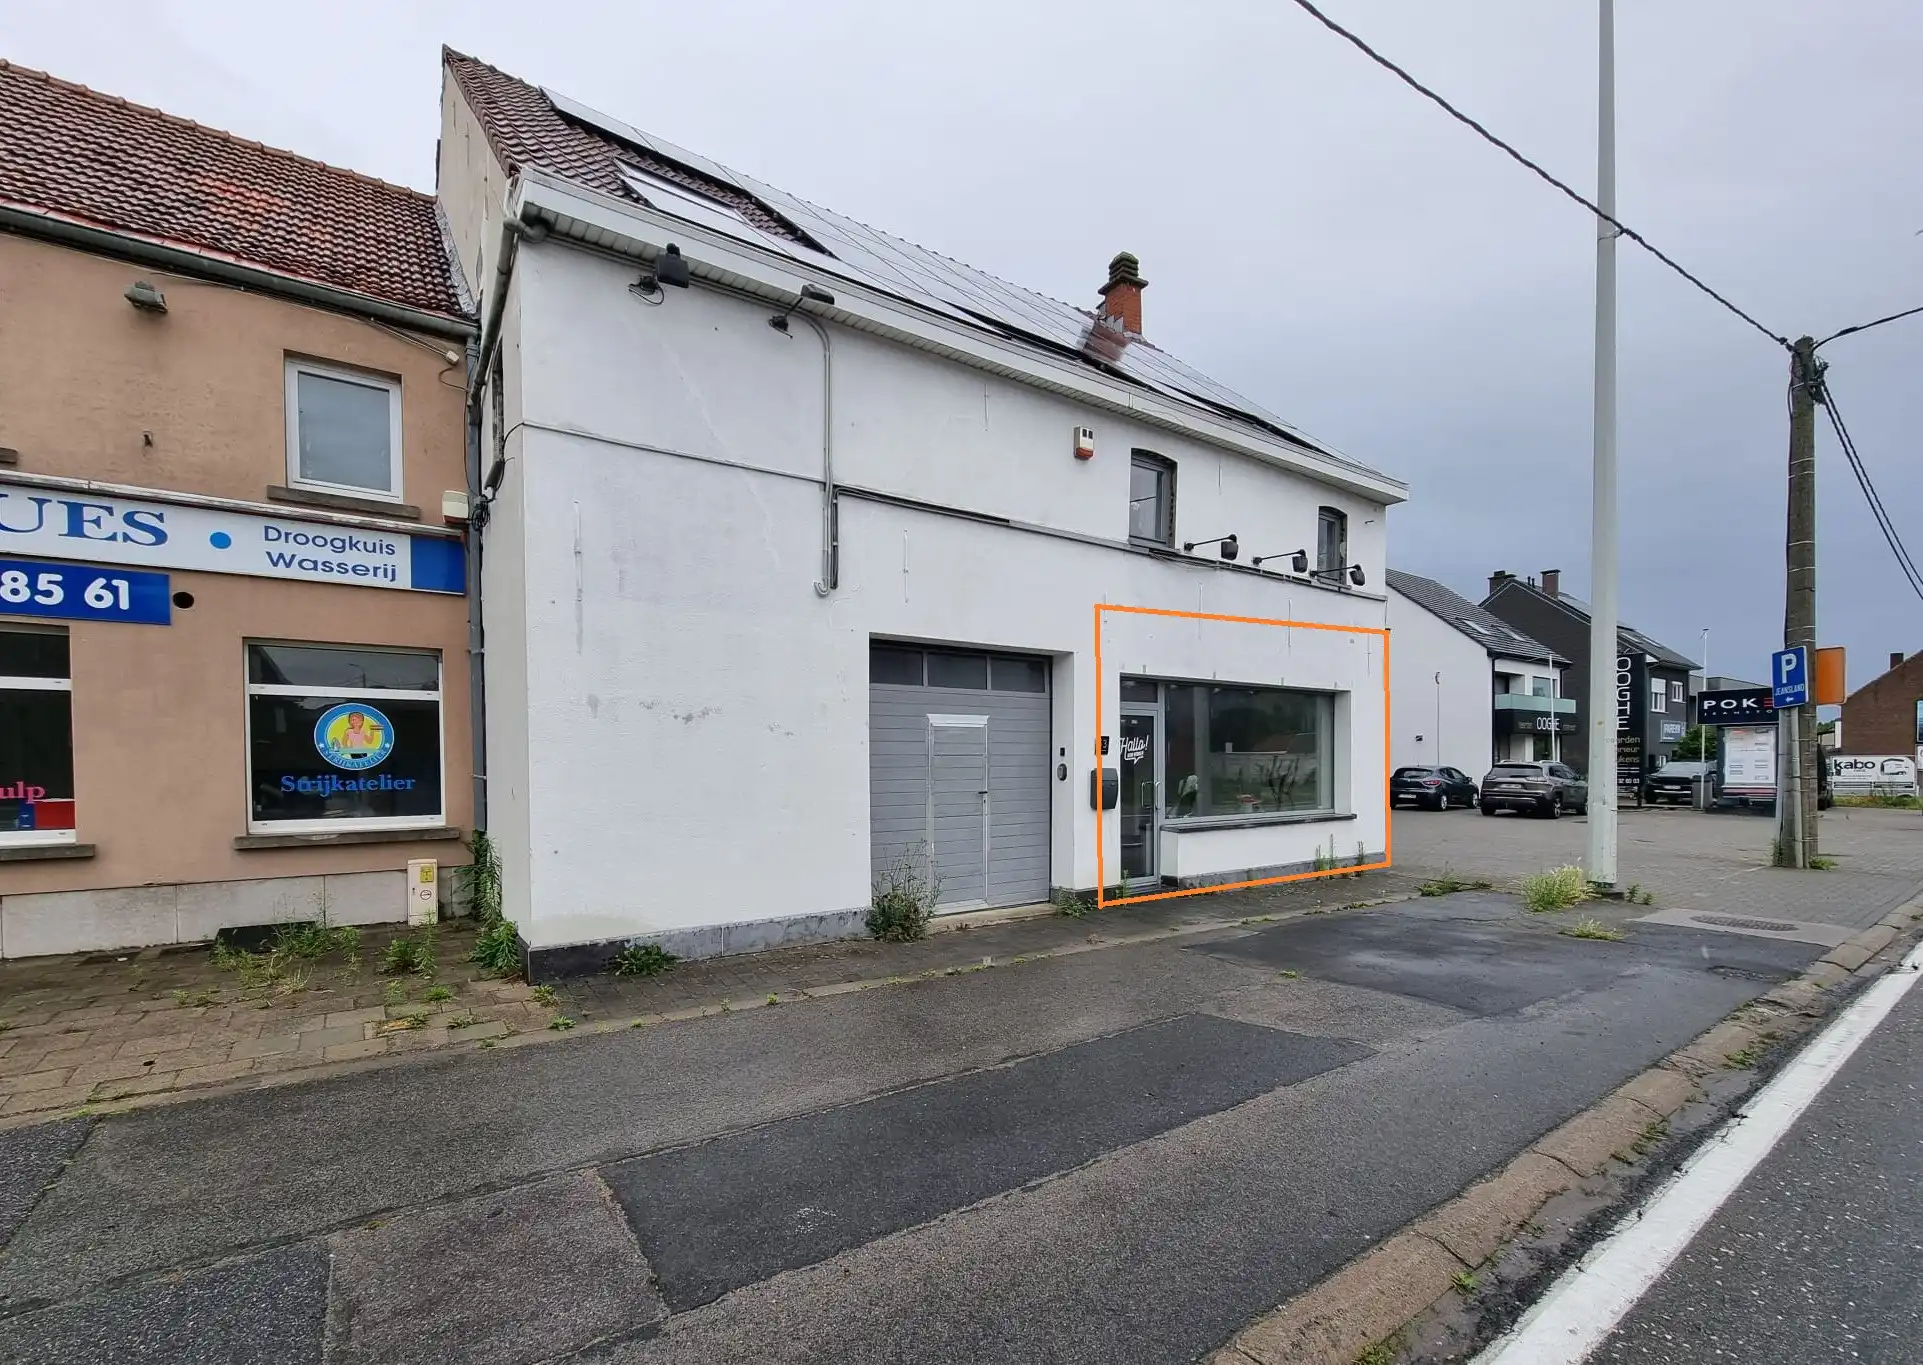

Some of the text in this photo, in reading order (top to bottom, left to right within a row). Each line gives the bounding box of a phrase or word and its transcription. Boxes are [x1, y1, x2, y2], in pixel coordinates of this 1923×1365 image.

[0, 493, 169, 547] UES
[264, 525, 396, 555] Droogkuis
[266, 551, 397, 582] Wasserij
[0, 570, 130, 610] 85 61
[1781, 653, 1797, 684] P
[1118, 734, 1149, 754] Hallo!
[1834, 758, 1876, 770] kabo
[0, 781, 46, 805] ulp
[281, 774, 416, 798] Strijkatelier
